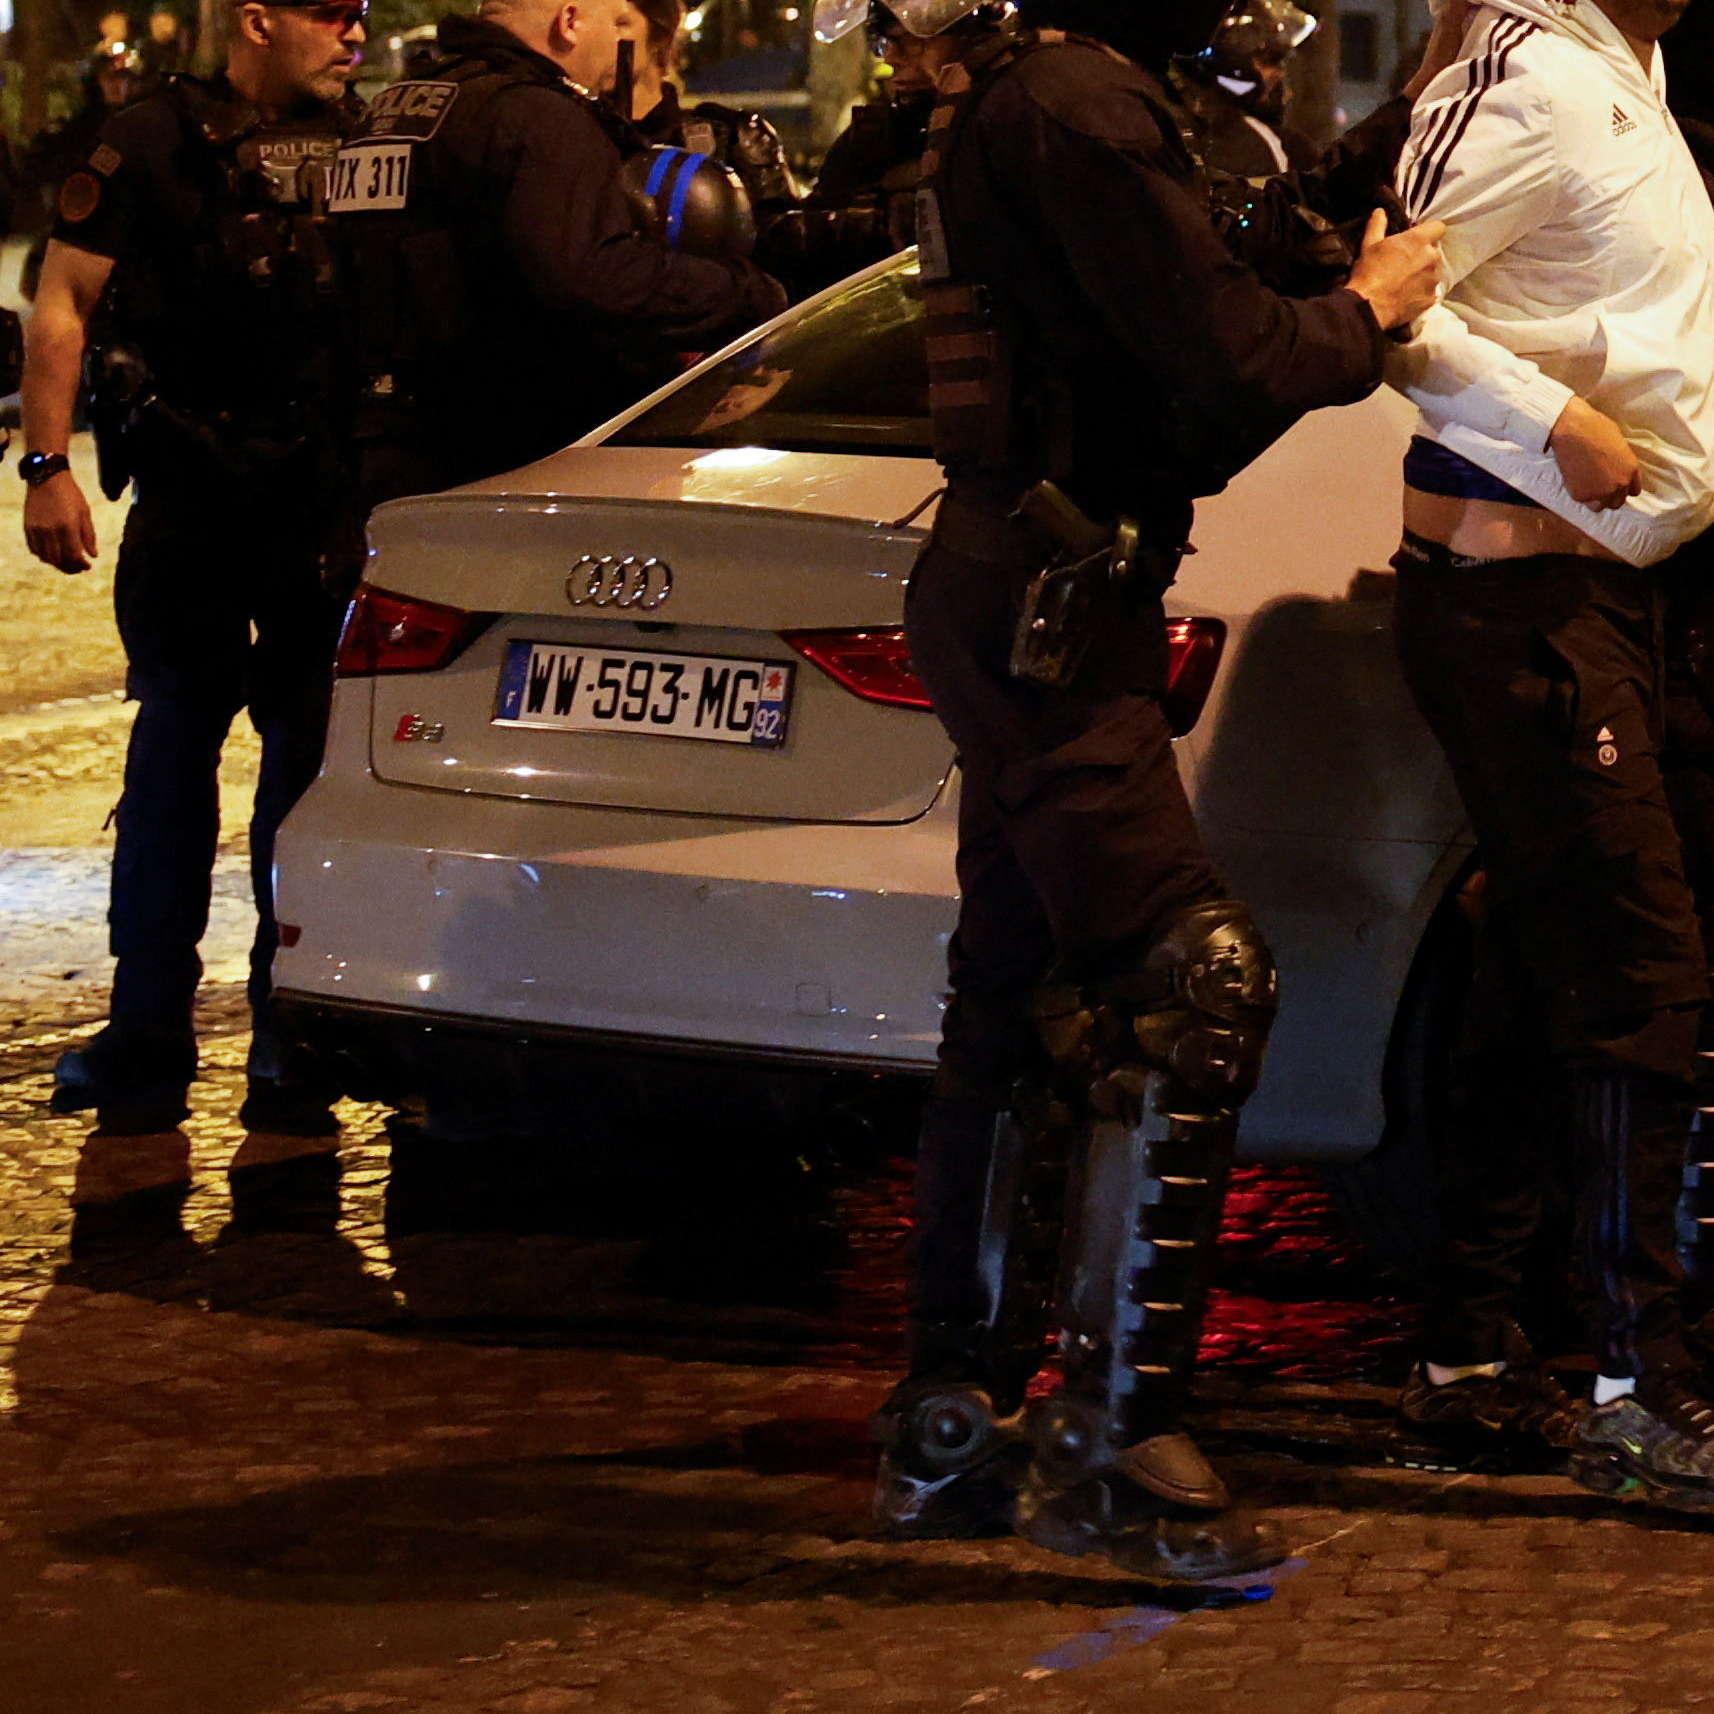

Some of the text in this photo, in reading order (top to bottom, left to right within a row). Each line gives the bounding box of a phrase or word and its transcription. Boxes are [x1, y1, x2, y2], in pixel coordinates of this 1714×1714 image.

[259, 141, 335, 159] POLICE
[367, 156, 407, 199] 311
[526, 652, 760, 732] WW-593-MG
[753, 707, 781, 739] 92
